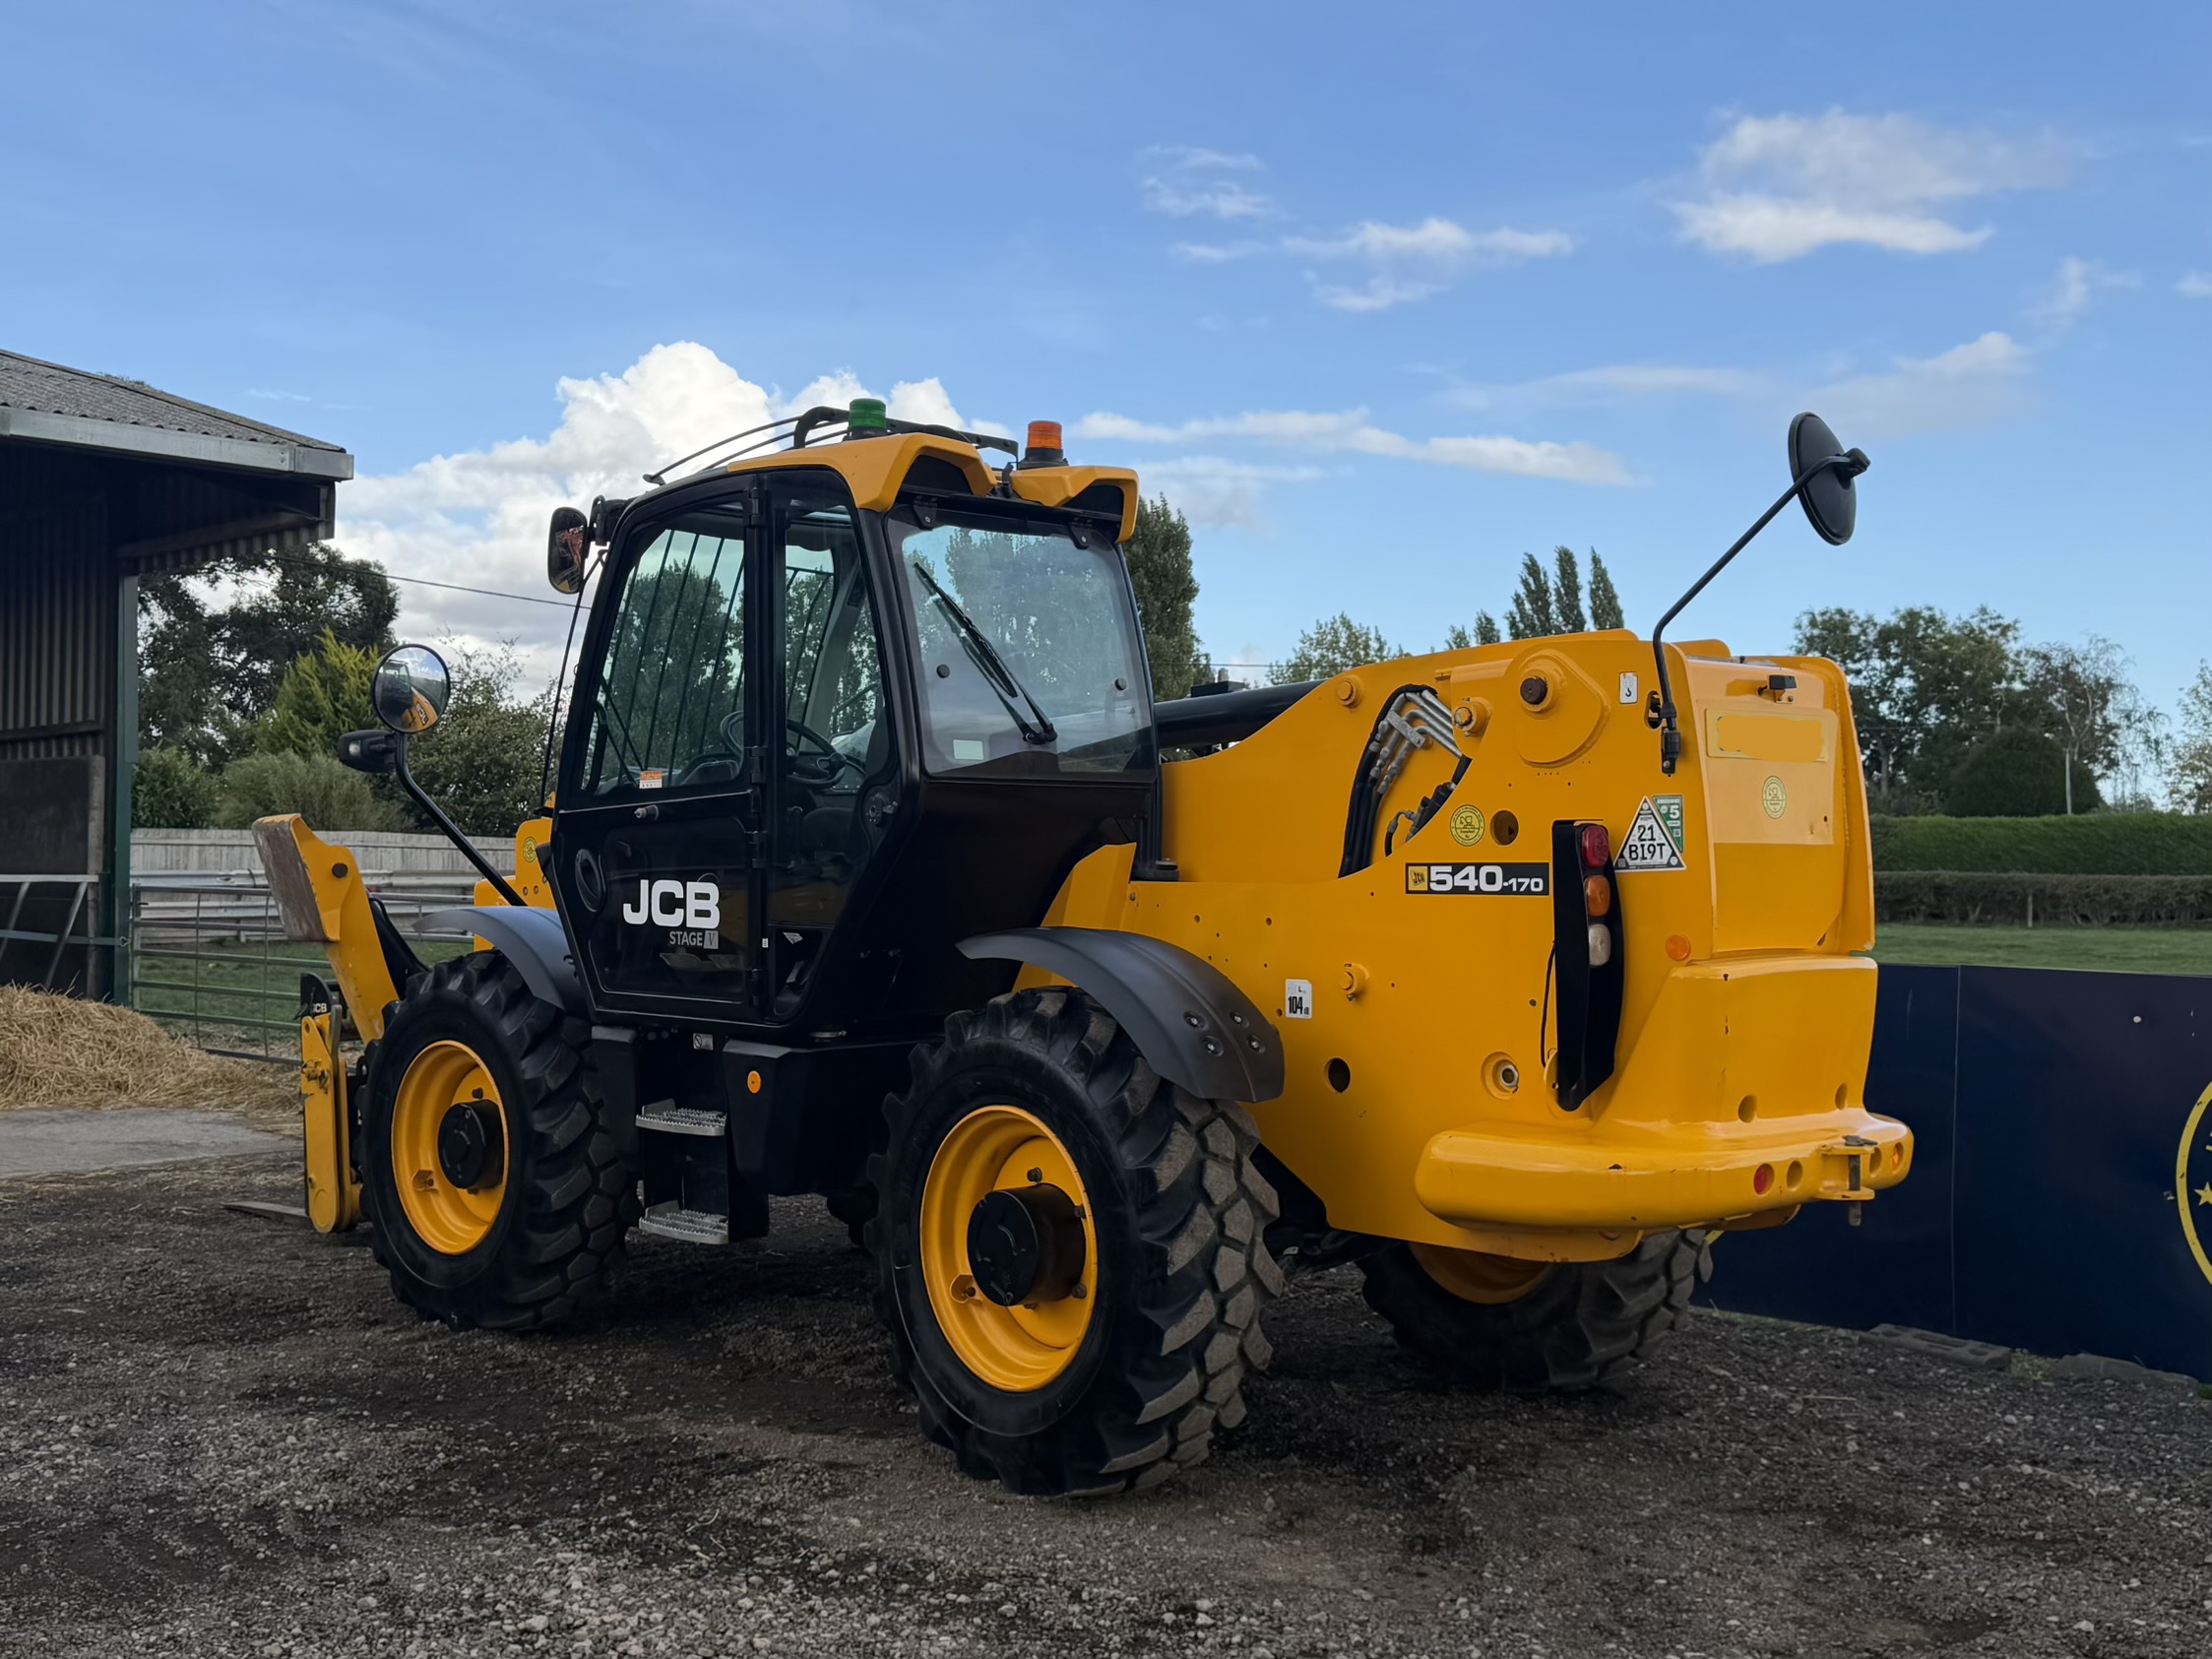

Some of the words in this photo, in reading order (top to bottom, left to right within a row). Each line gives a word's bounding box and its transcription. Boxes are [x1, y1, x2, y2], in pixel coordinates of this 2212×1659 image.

[1670, 804, 1679, 819] 5
[1637, 824, 1656, 842] 21
[1429, 865, 1544, 892] 540-170
[623, 879, 721, 929] JCB
[669, 930, 703, 946] STAGE
[1288, 995, 1302, 1014] 104
